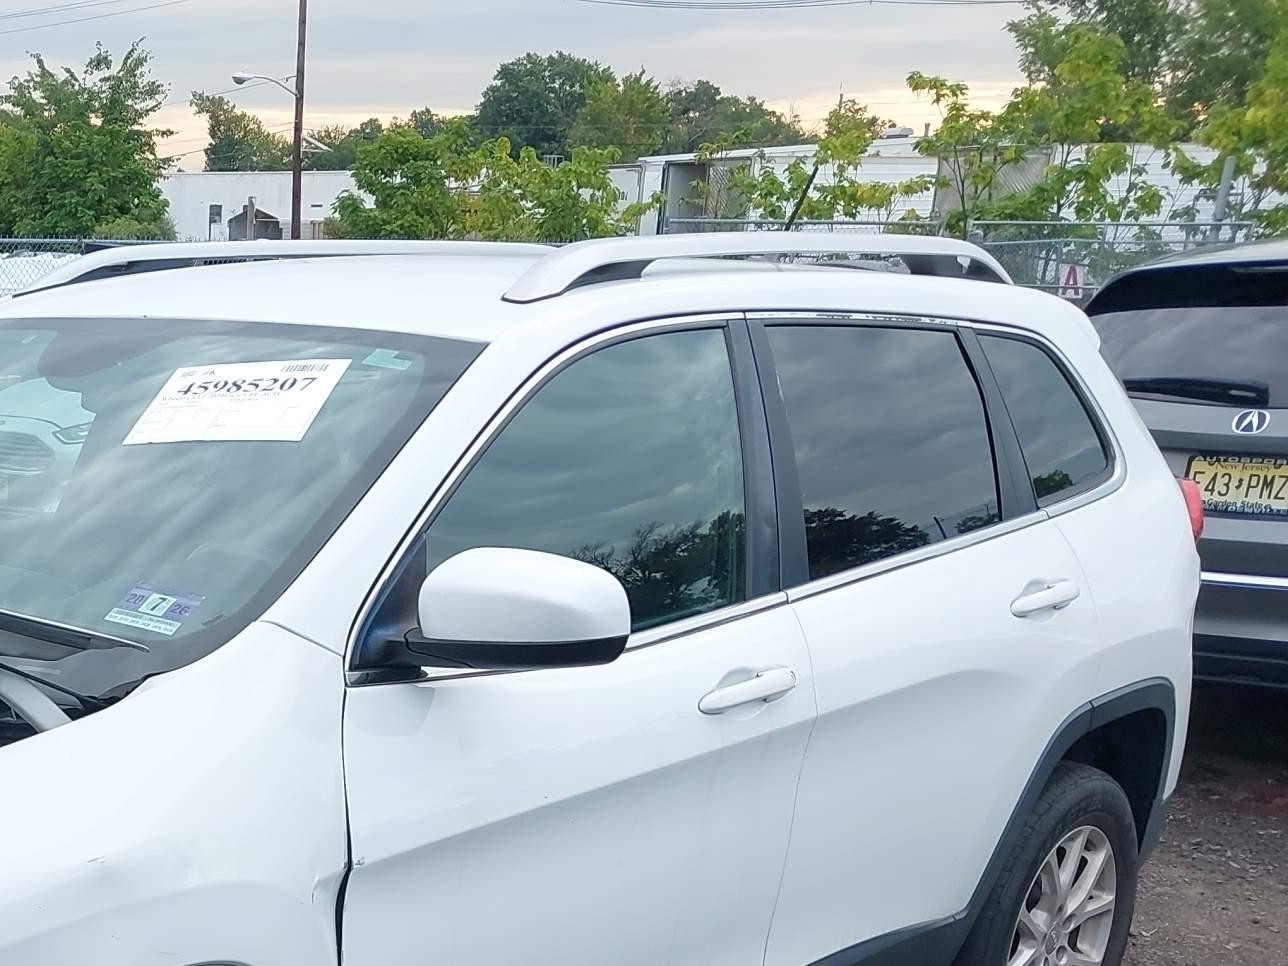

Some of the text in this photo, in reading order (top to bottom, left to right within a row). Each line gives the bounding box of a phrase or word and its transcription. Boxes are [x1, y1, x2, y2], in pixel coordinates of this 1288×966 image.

[1062, 265, 1080, 296] A
[177, 377, 318, 396] 45985207
[1216, 462, 1271, 472] New Jersey
[1244, 473, 1288, 500] PMZ
[127, 593, 190, 616] 20 7 26
